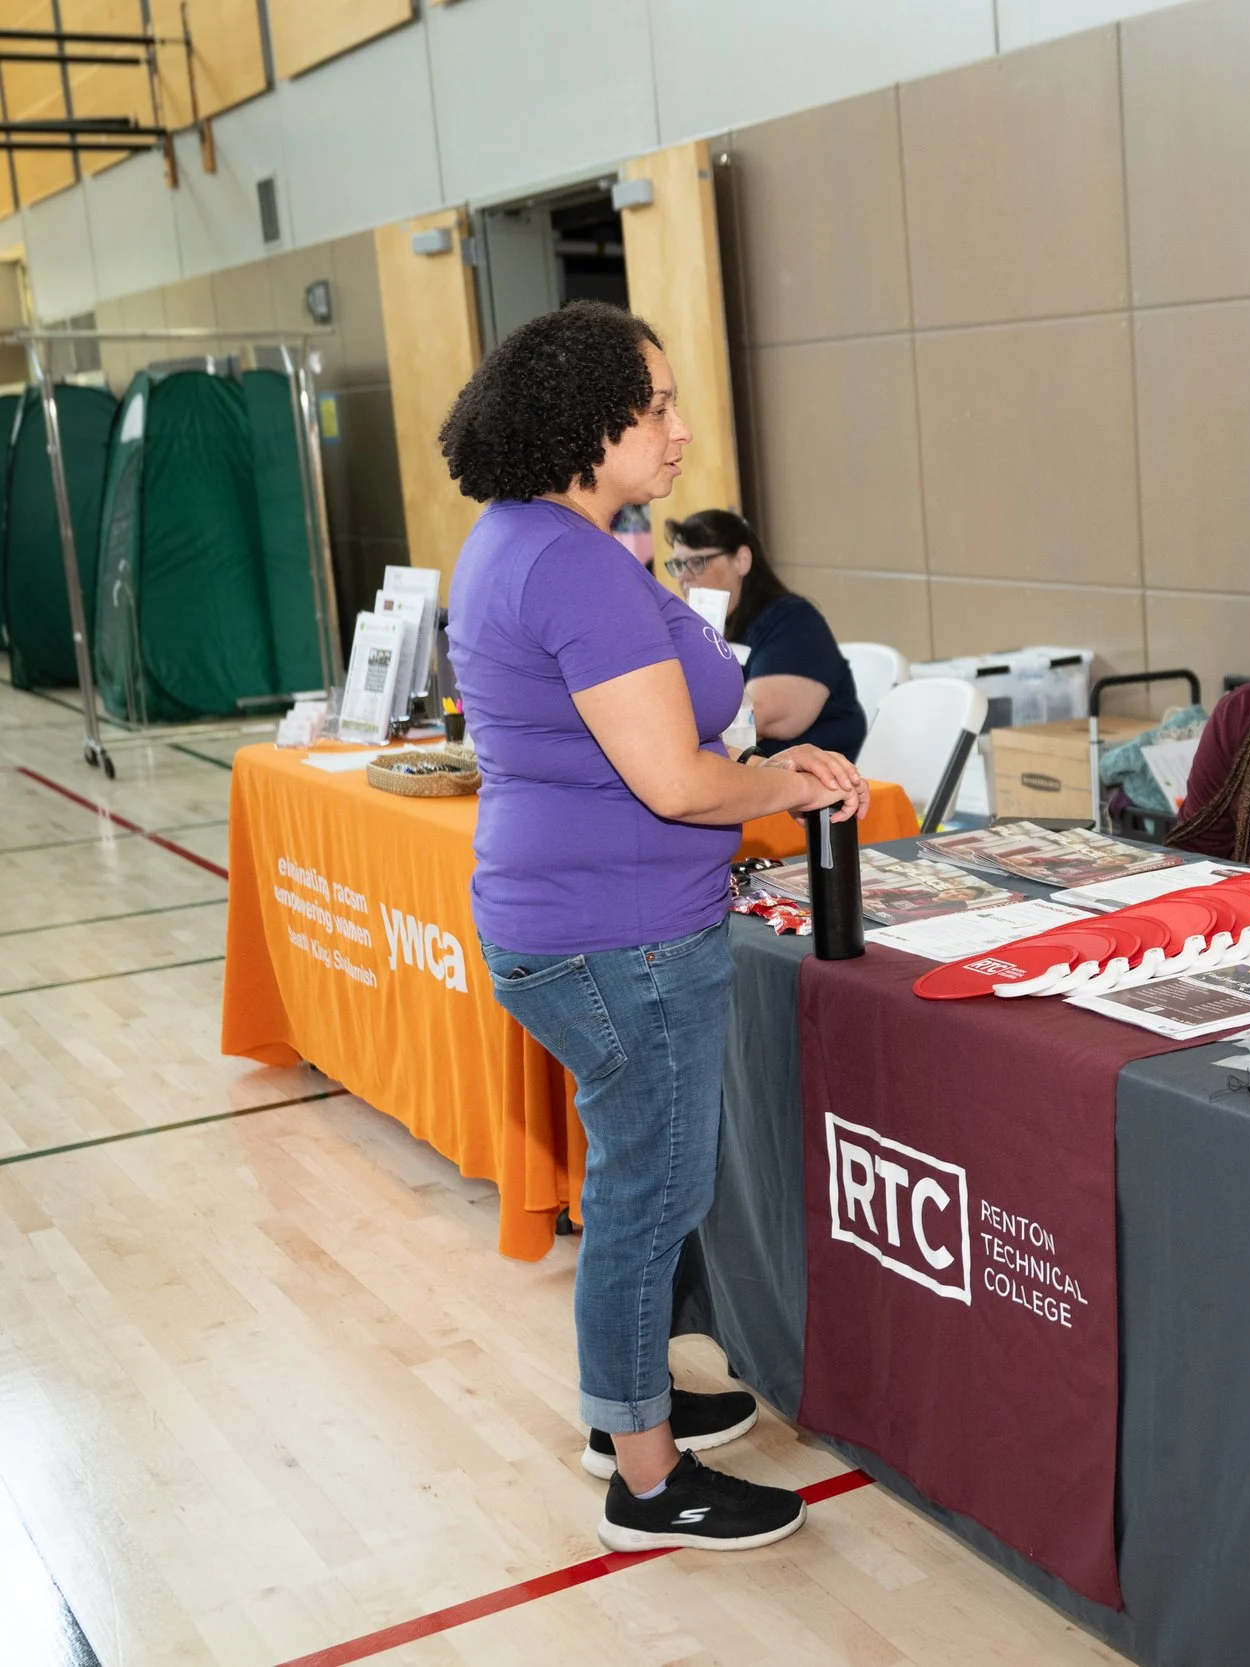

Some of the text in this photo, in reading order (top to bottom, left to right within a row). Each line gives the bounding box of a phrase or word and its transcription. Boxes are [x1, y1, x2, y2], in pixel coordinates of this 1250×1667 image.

[332, 882, 368, 914] racsm
[334, 915, 372, 948] women
[380, 902, 469, 993] ywca
[970, 961, 1008, 973] RTC
[839, 1138, 955, 1270] RTC
[981, 1199, 1056, 1255] RENTON
[981, 1232, 1088, 1305] TECHNICAL
[983, 1267, 1072, 1328] COLLEGE
